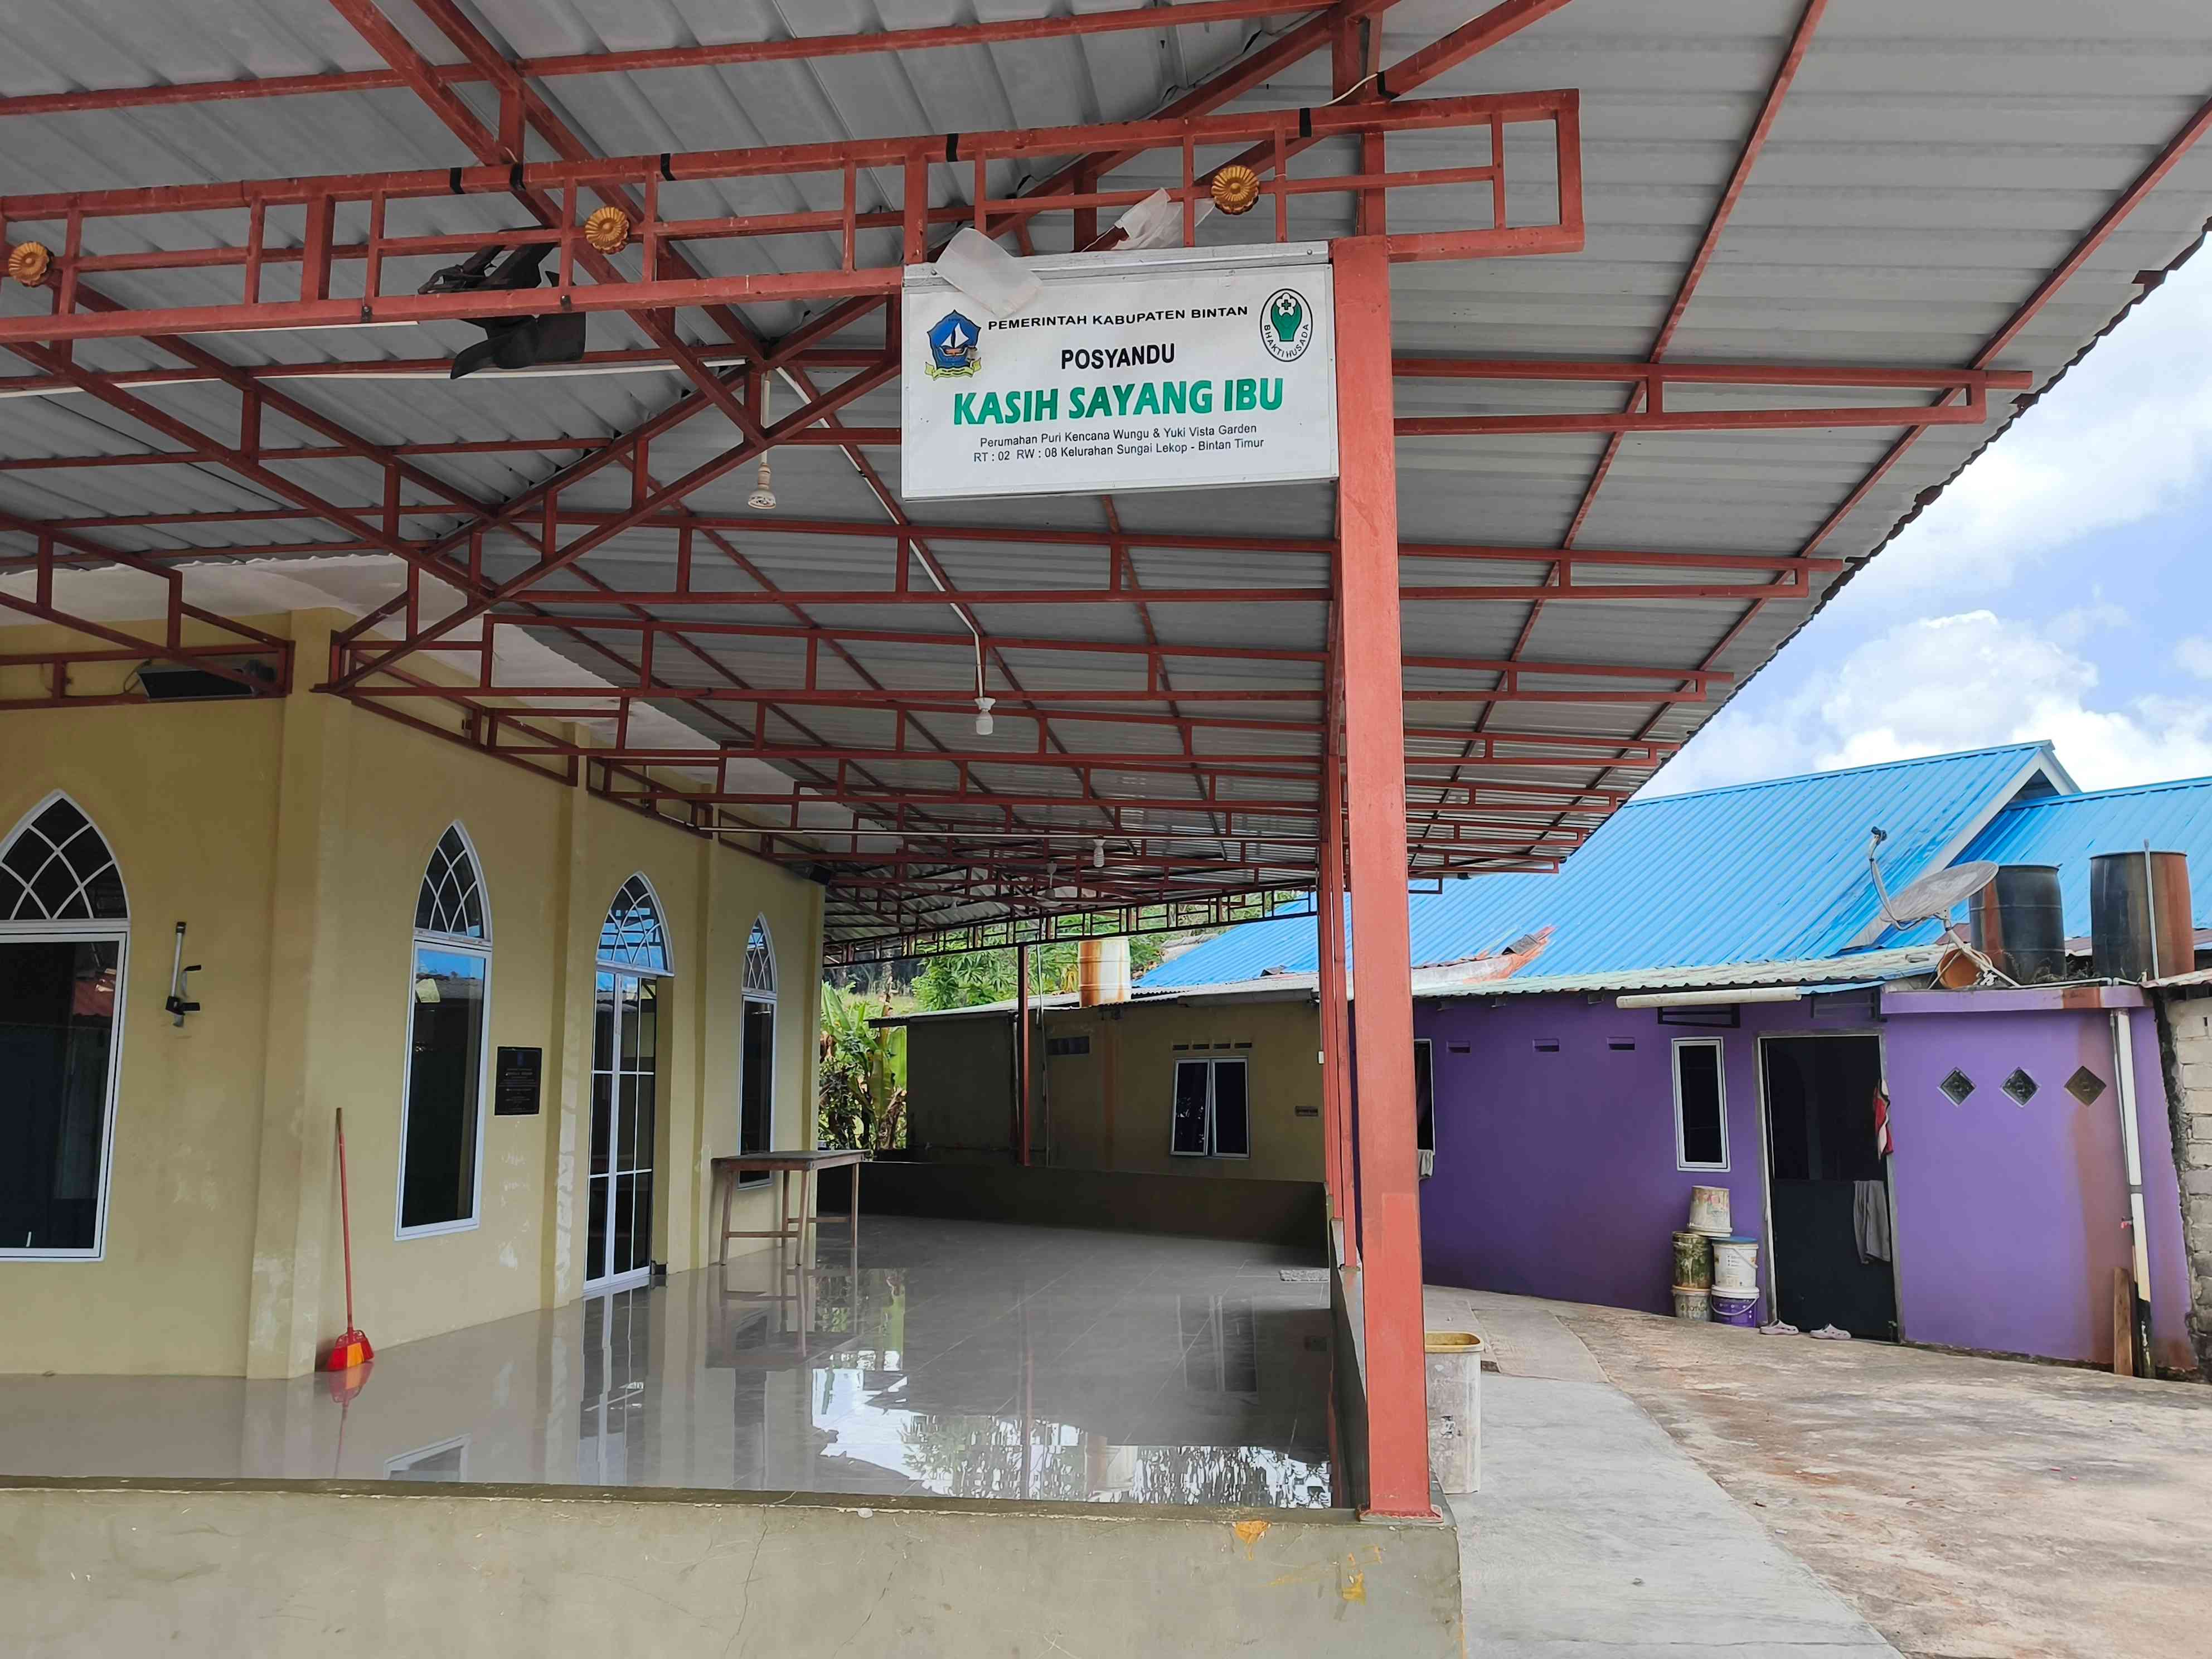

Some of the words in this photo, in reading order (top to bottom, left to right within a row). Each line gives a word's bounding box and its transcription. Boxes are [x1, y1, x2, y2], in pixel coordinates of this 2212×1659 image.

[988, 315, 1087, 330] PEMERINTAH
[1093, 309, 1185, 325] KABUPATEN
[1191, 306, 1248, 318] BINTAN
[1264, 324, 1284, 357] BHAKTI
[1286, 324, 1309, 358] HUSADA
[1061, 343, 1175, 370] POSYANDU
[954, 388, 1059, 425] KASIH
[1069, 380, 1212, 419] SAYANG
[1224, 378, 1284, 411] IBU
[980, 435, 1037, 447] Perumahan
[1041, 432, 1061, 443] Puri
[1065, 431, 1110, 442] Kencana
[1113, 428, 1149, 441] Wungu
[1153, 428, 1161, 438] &
[1164, 426, 1186, 438] Yuki
[1189, 426, 1215, 437] Vista
[1218, 424, 1257, 435] Garden
[974, 452, 988, 462] RT
[998, 451, 1010, 461] 02
[1017, 448, 1035, 459] RW
[1045, 448, 1057, 458] 08
[1061, 445, 1113, 457] Kelurahan
[1117, 443, 1153, 455] Sungai
[1156, 442, 1187, 454] Lekop
[1199, 440, 1231, 451] Bintan
[1234, 438, 1264, 449] Timur
